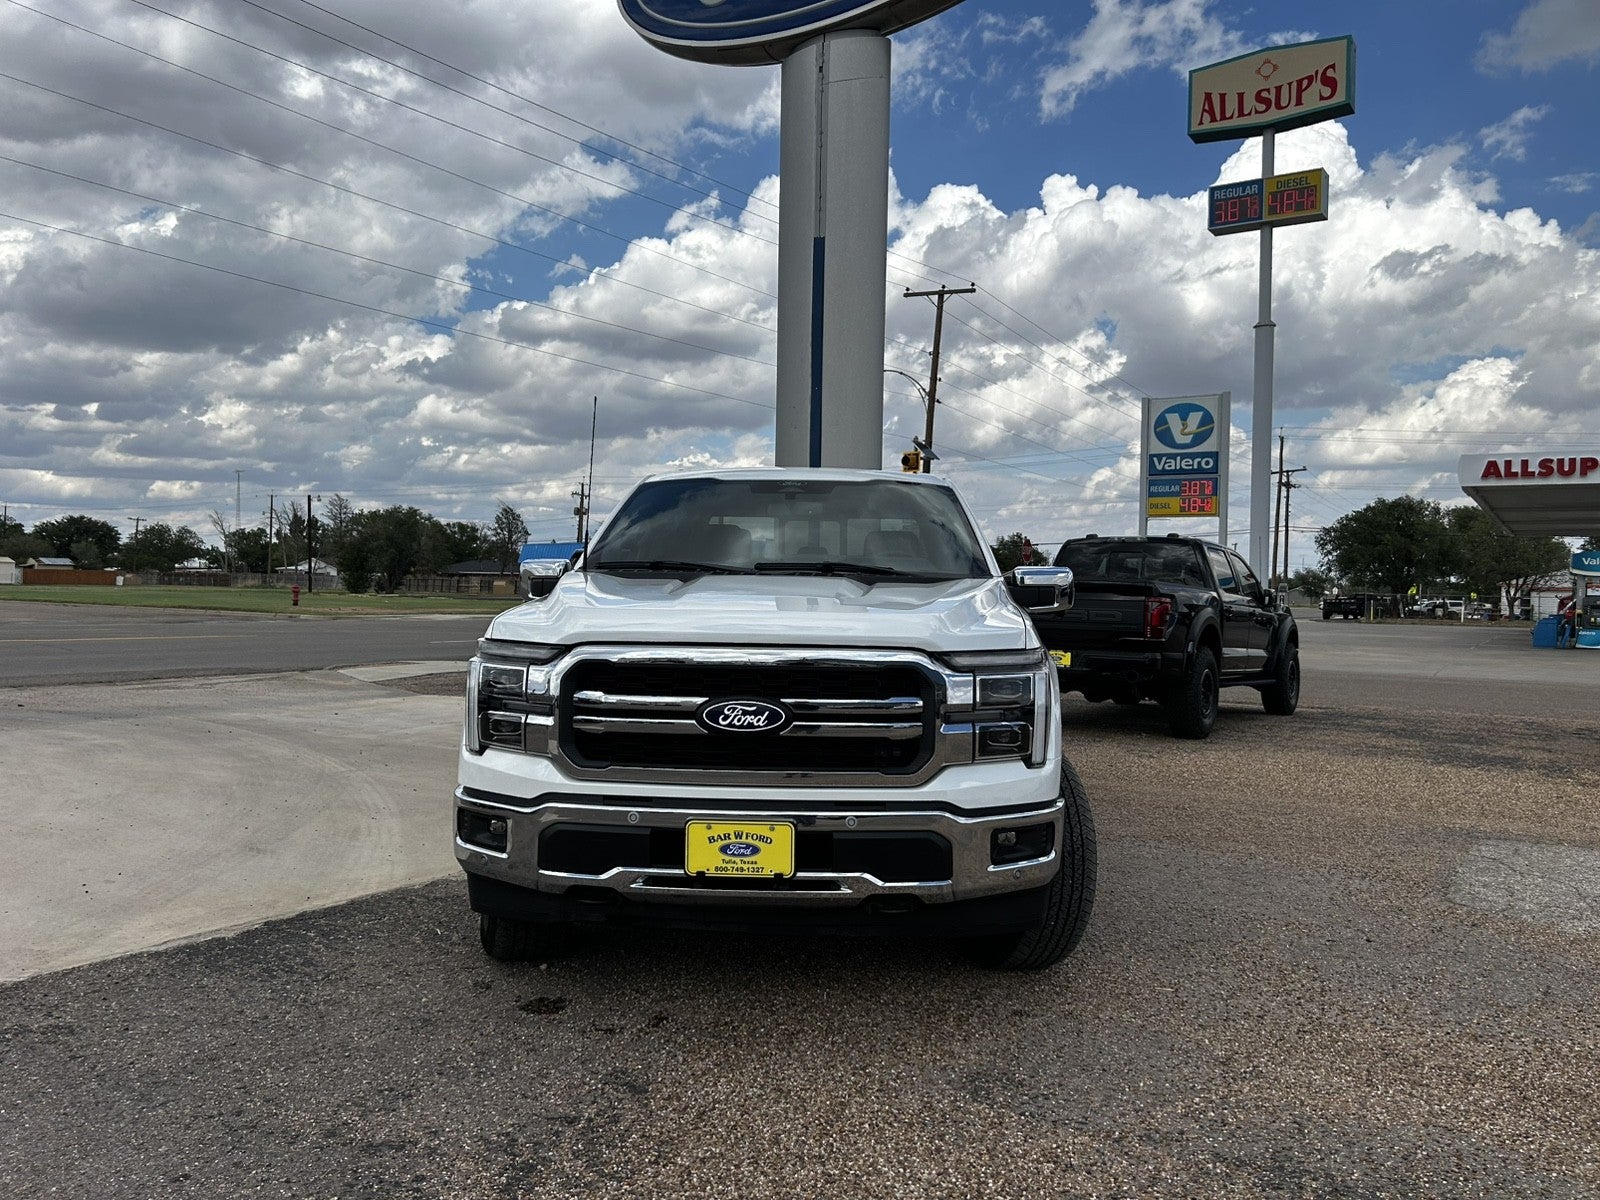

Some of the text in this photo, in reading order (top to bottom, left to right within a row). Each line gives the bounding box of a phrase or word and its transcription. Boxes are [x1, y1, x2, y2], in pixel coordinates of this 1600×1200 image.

[1198, 63, 1338, 126] ALLSUP'S
[1276, 176, 1311, 189] DIESEL
[1214, 184, 1259, 199] REGULAR
[1153, 456, 1214, 470] Valero
[1481, 457, 1599, 479] ALLSUP
[718, 705, 770, 726] Ford
[707, 830, 773, 845] BAR W FORD
[726, 843, 753, 855] Ford
[714, 865, 765, 873] 800-749-1327
